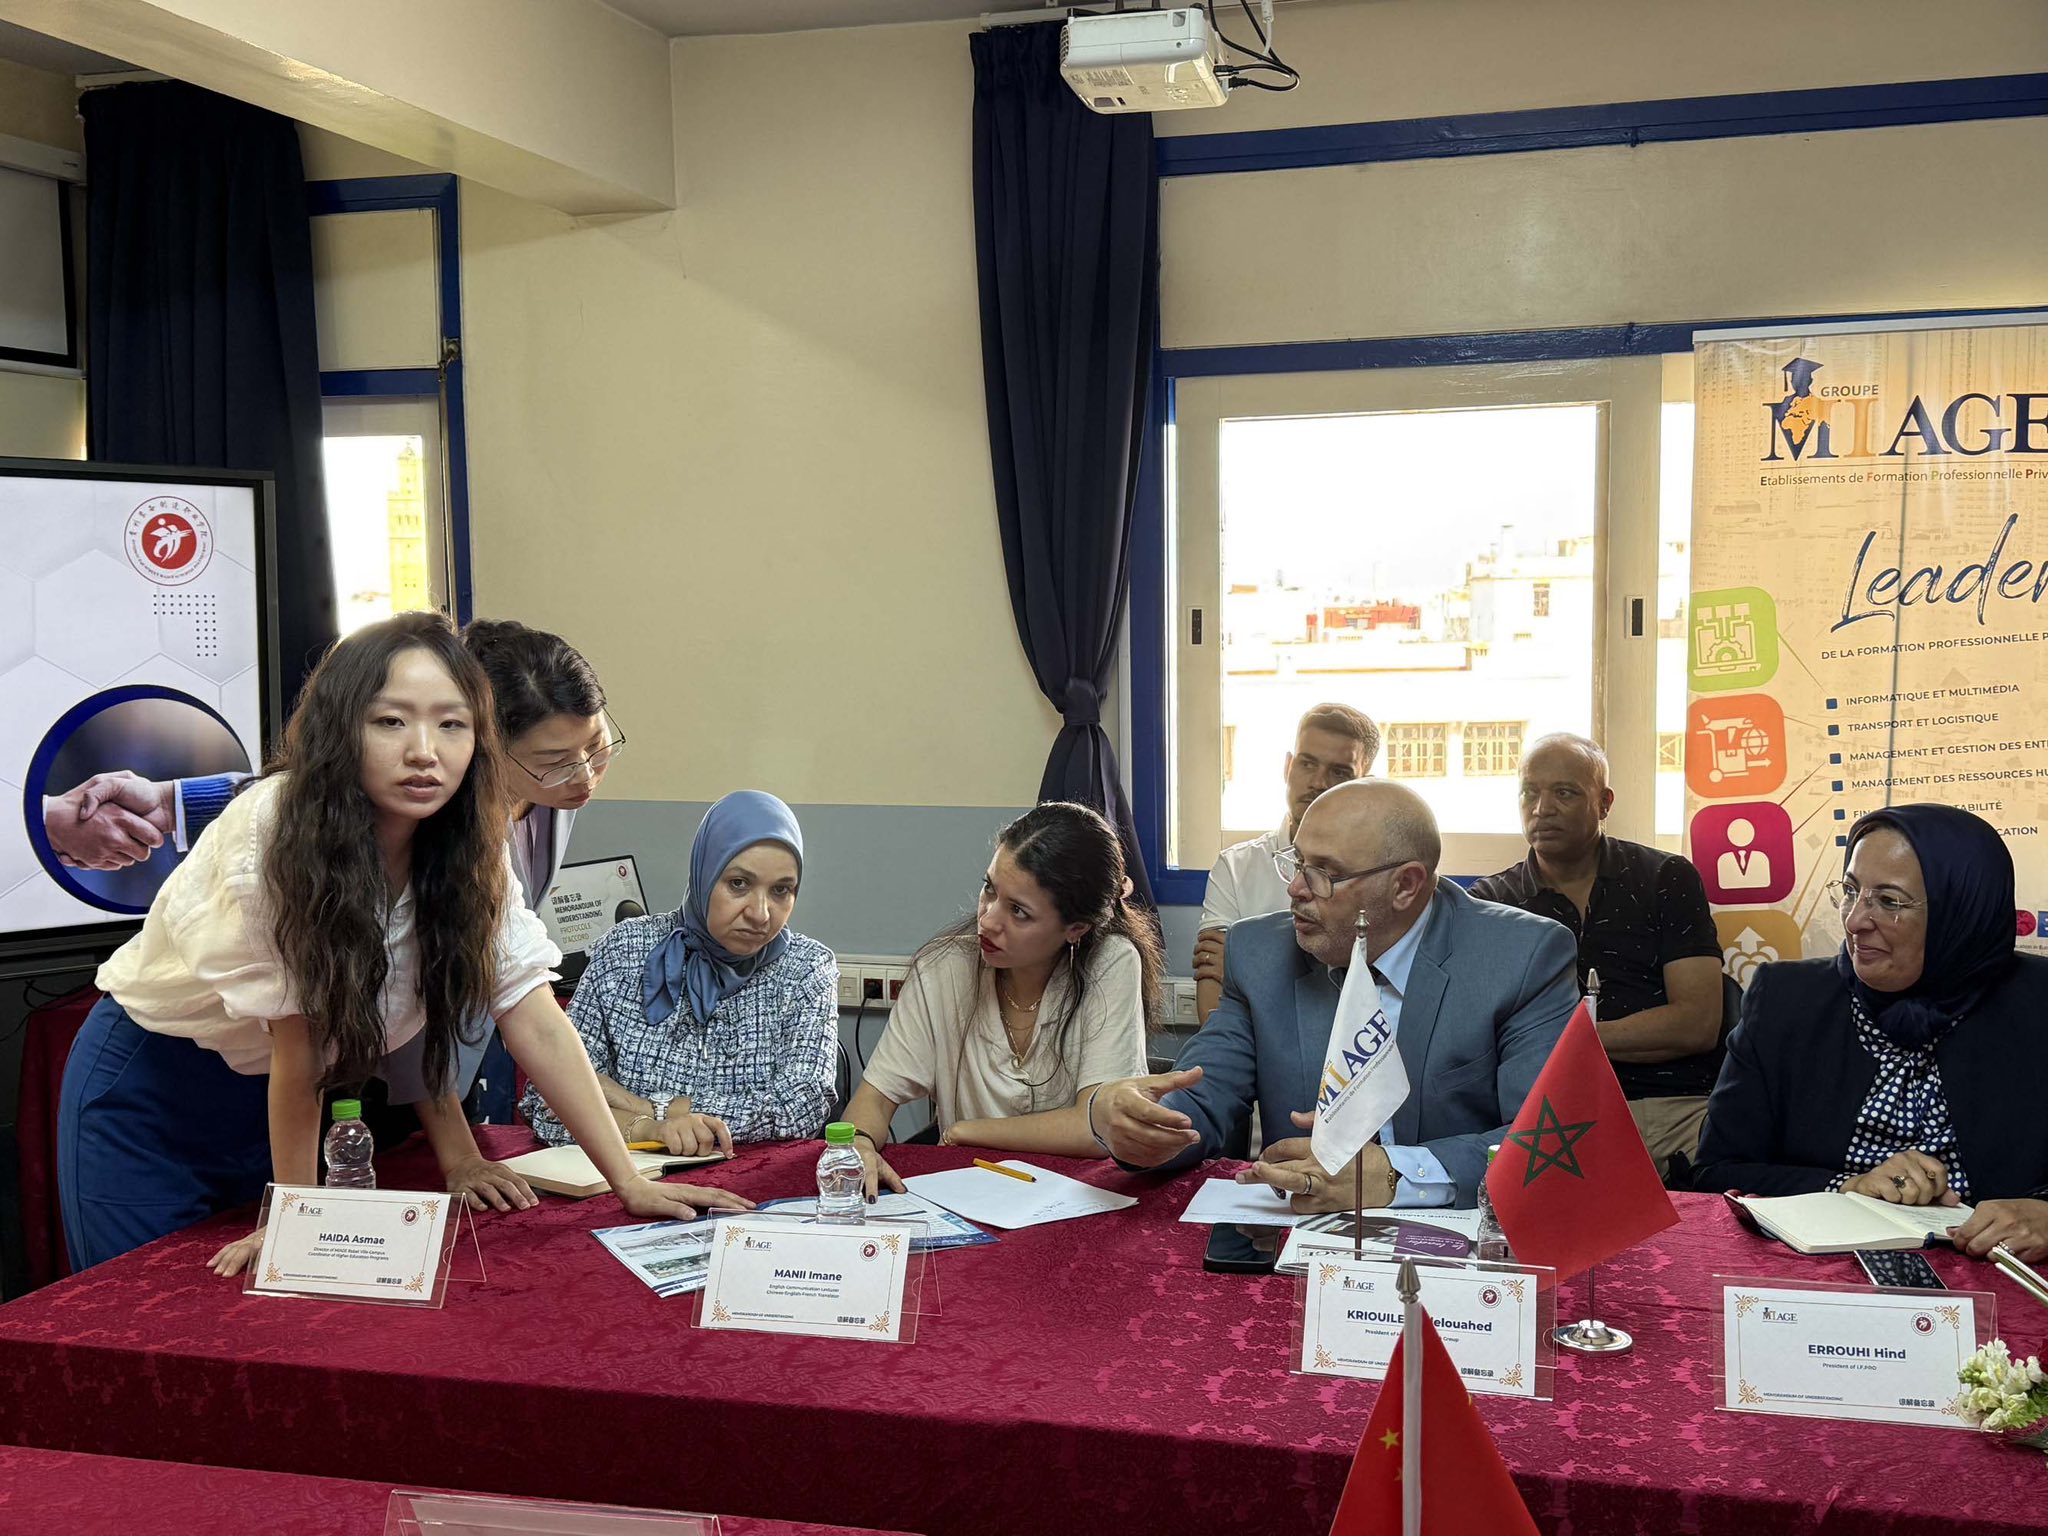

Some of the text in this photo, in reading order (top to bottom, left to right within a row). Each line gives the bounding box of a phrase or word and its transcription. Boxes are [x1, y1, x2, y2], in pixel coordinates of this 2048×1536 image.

[1821, 385, 1879, 397] GROUPE
[1760, 393, 2048, 461] MIAGE
[1760, 472, 1846, 486] Etablissements
[1849, 472, 1863, 483] de
[1866, 470, 1928, 482] Formation
[1931, 468, 2022, 481] Professionnelle
[1821, 651, 1837, 660] DE
[1840, 649, 1854, 658] LA
[1857, 642, 1925, 657] FORMATION
[1928, 632, 2039, 650] PROFESSIONNELLE
[1846, 691, 1930, 706] INFORMATIQUE
[1933, 689, 1946, 698] ET
[1848, 713, 1999, 732] TRANSPORT ET LOGISTIQUE
[1850, 748, 1929, 761] MANAGEMENT
[1931, 746, 1945, 755] ET
[1947, 743, 1996, 754] GESTION
[1999, 741, 2021, 751] DES
[1851, 775, 1930, 789] MANAGEMENT
[1933, 774, 1956, 783] DES
[1958, 768, 2033, 781] RESSOURCES
[1318, 1009, 1391, 1116] MIAGE
[319, 1232, 385, 1245] HAIDA Asmae
[774, 1268, 842, 1281] MANII Imane
[1347, 1309, 1405, 1323] KRIOUILE
[1808, 1344, 1906, 1359] ERROUHI Hind
